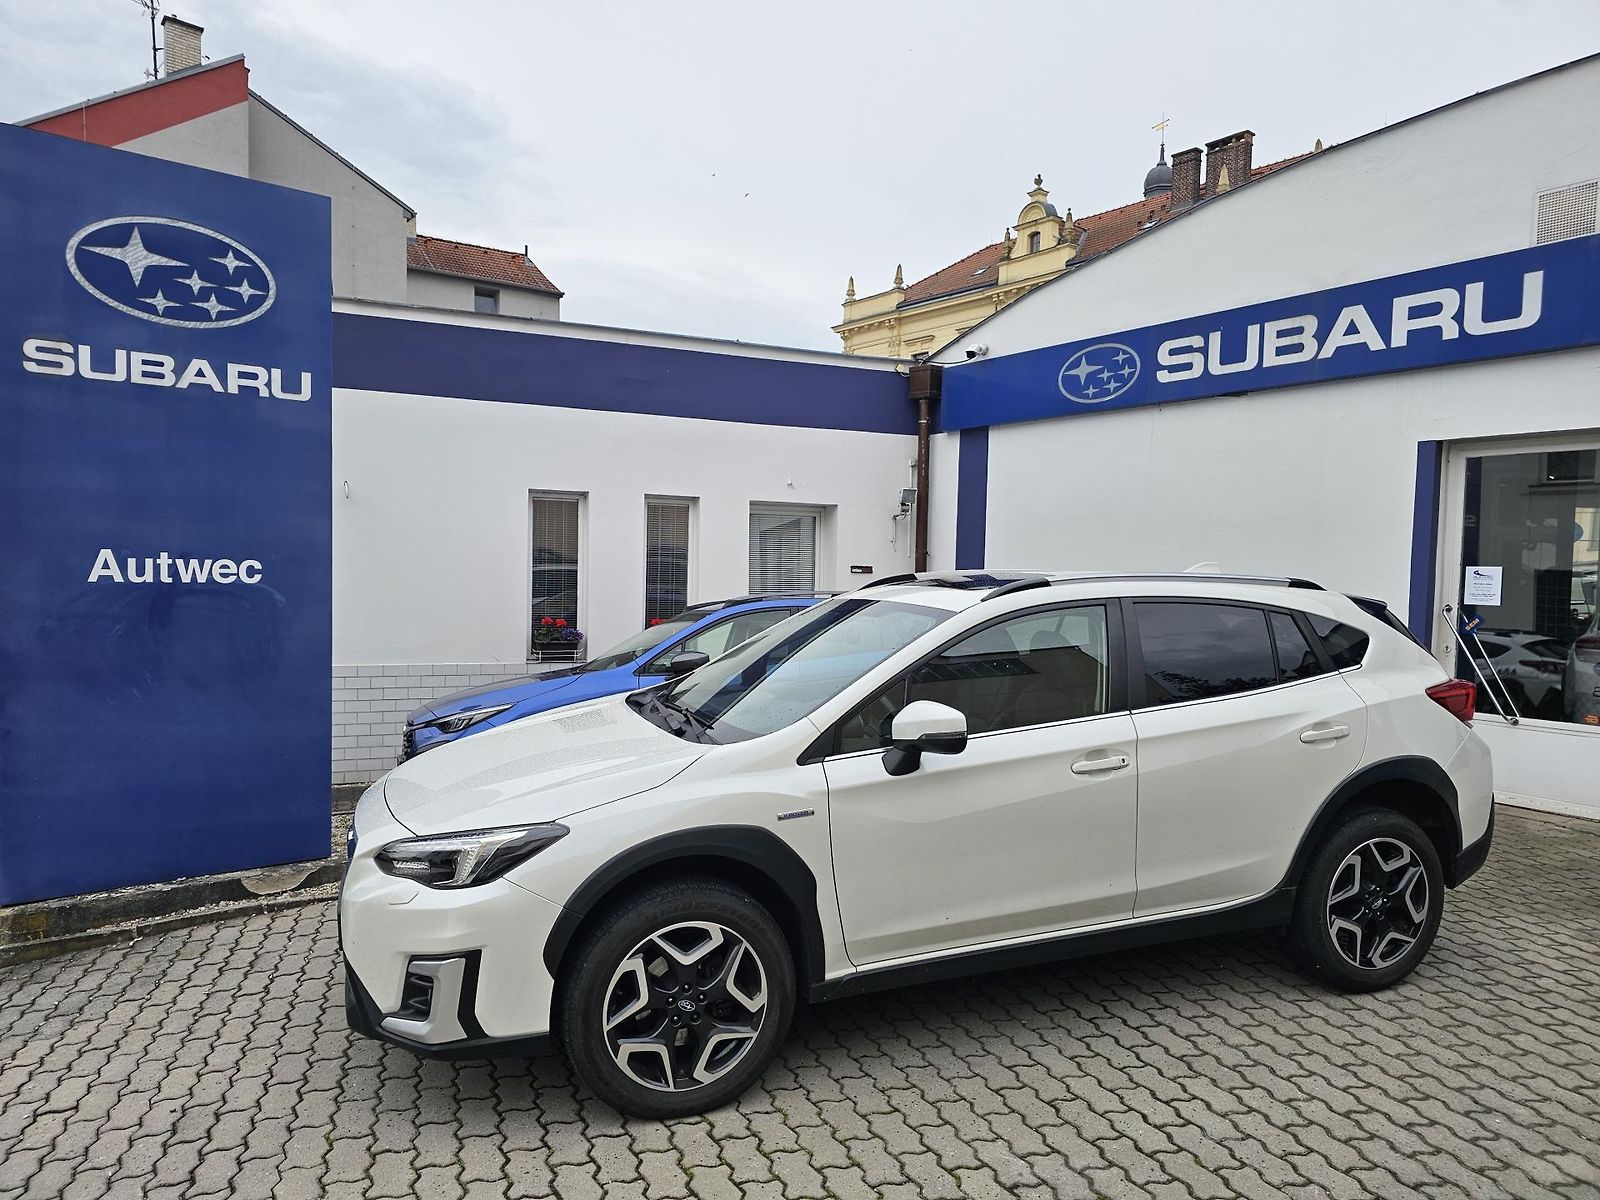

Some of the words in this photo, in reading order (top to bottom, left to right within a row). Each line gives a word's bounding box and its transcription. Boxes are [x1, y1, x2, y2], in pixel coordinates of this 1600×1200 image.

[1156, 270, 1544, 384] SUBARU
[22, 338, 312, 402] SUBARU
[87, 548, 263, 584] Autwec
